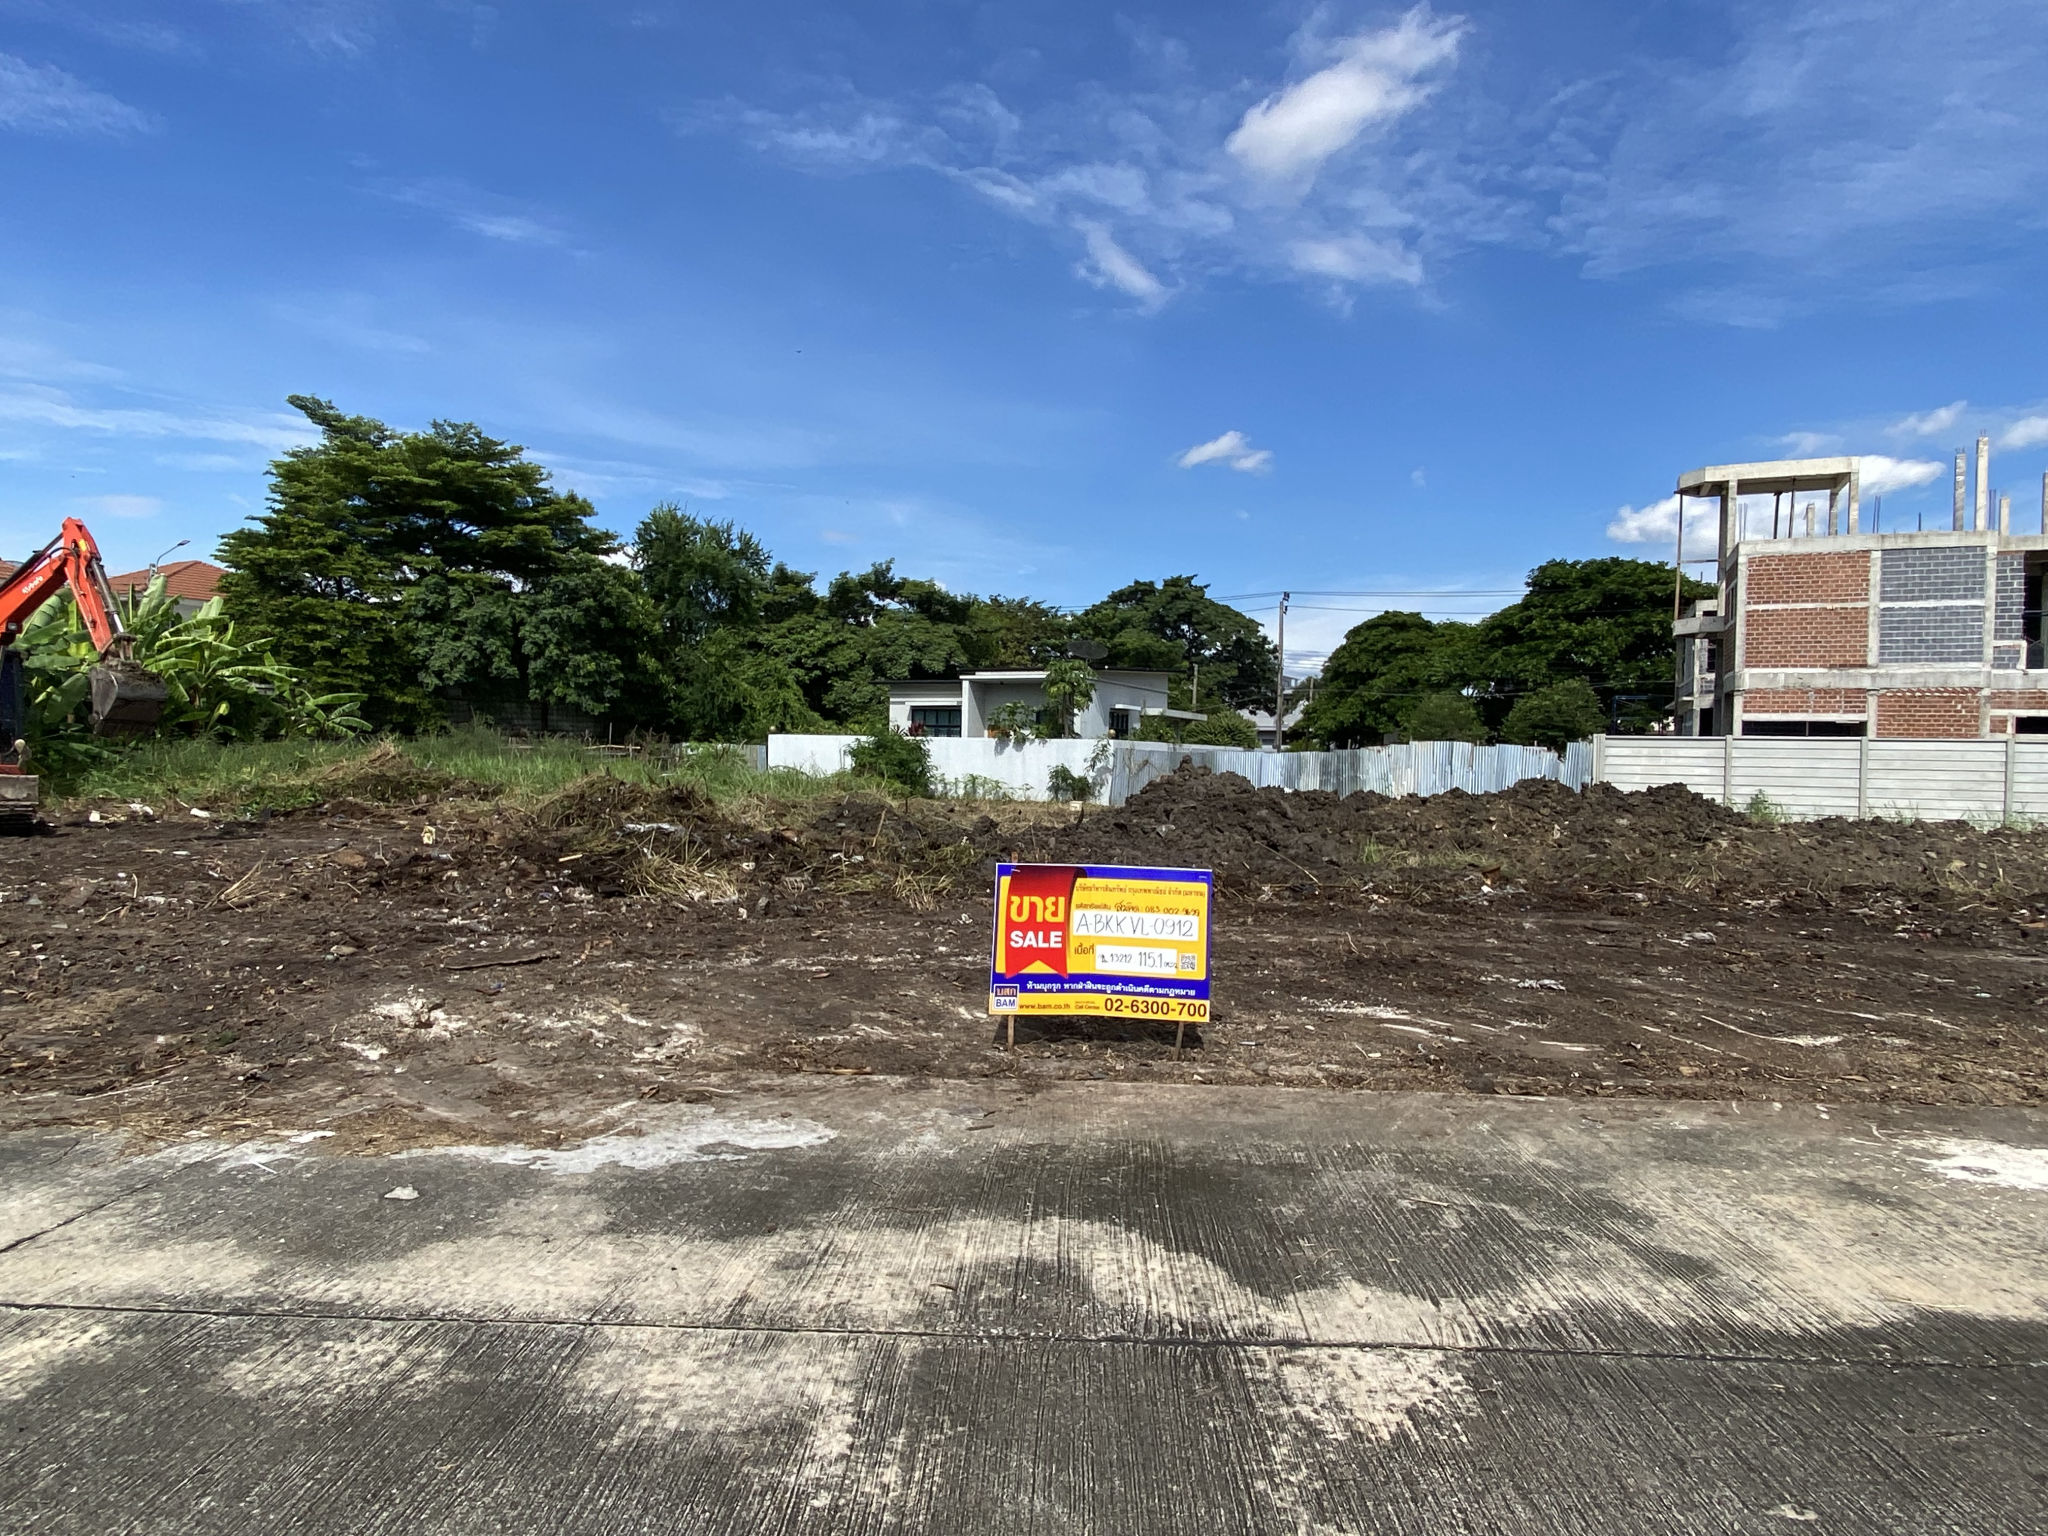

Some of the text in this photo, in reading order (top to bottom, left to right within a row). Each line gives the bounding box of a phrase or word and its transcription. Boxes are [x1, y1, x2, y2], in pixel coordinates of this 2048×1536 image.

[1010, 896, 1065, 923] ขาย
[1010, 930, 1063, 948] SALE
[995, 999, 1016, 1007] BAM
[1104, 998, 1207, 1017] 02-6300-700
